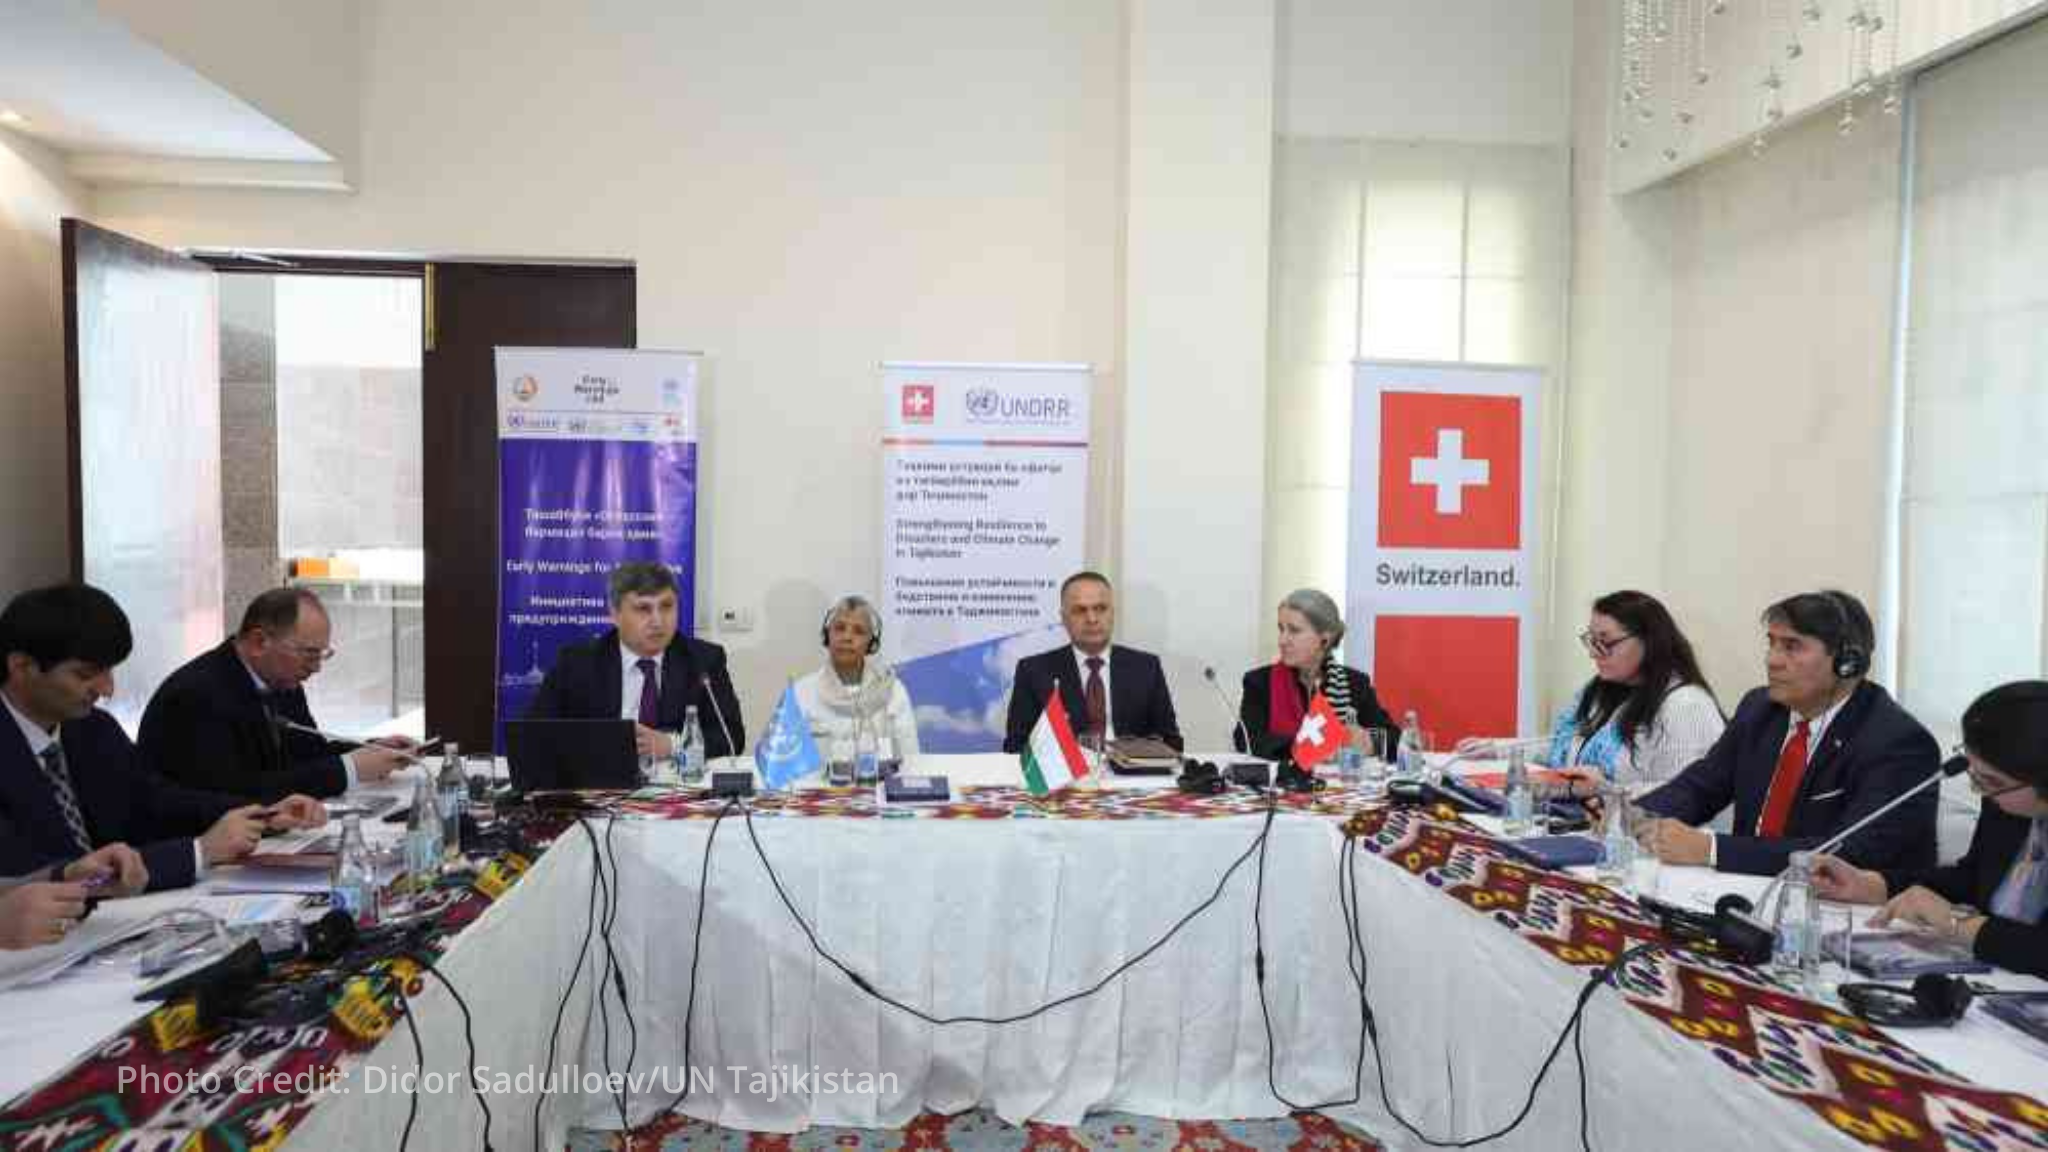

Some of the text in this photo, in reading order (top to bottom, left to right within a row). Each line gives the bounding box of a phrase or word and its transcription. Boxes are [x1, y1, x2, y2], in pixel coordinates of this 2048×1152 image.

[1001, 394, 1070, 417] UNDRR
[507, 560, 534, 574] Early
[538, 560, 591, 575] Warnings
[1376, 561, 1521, 588] Switzerland.
